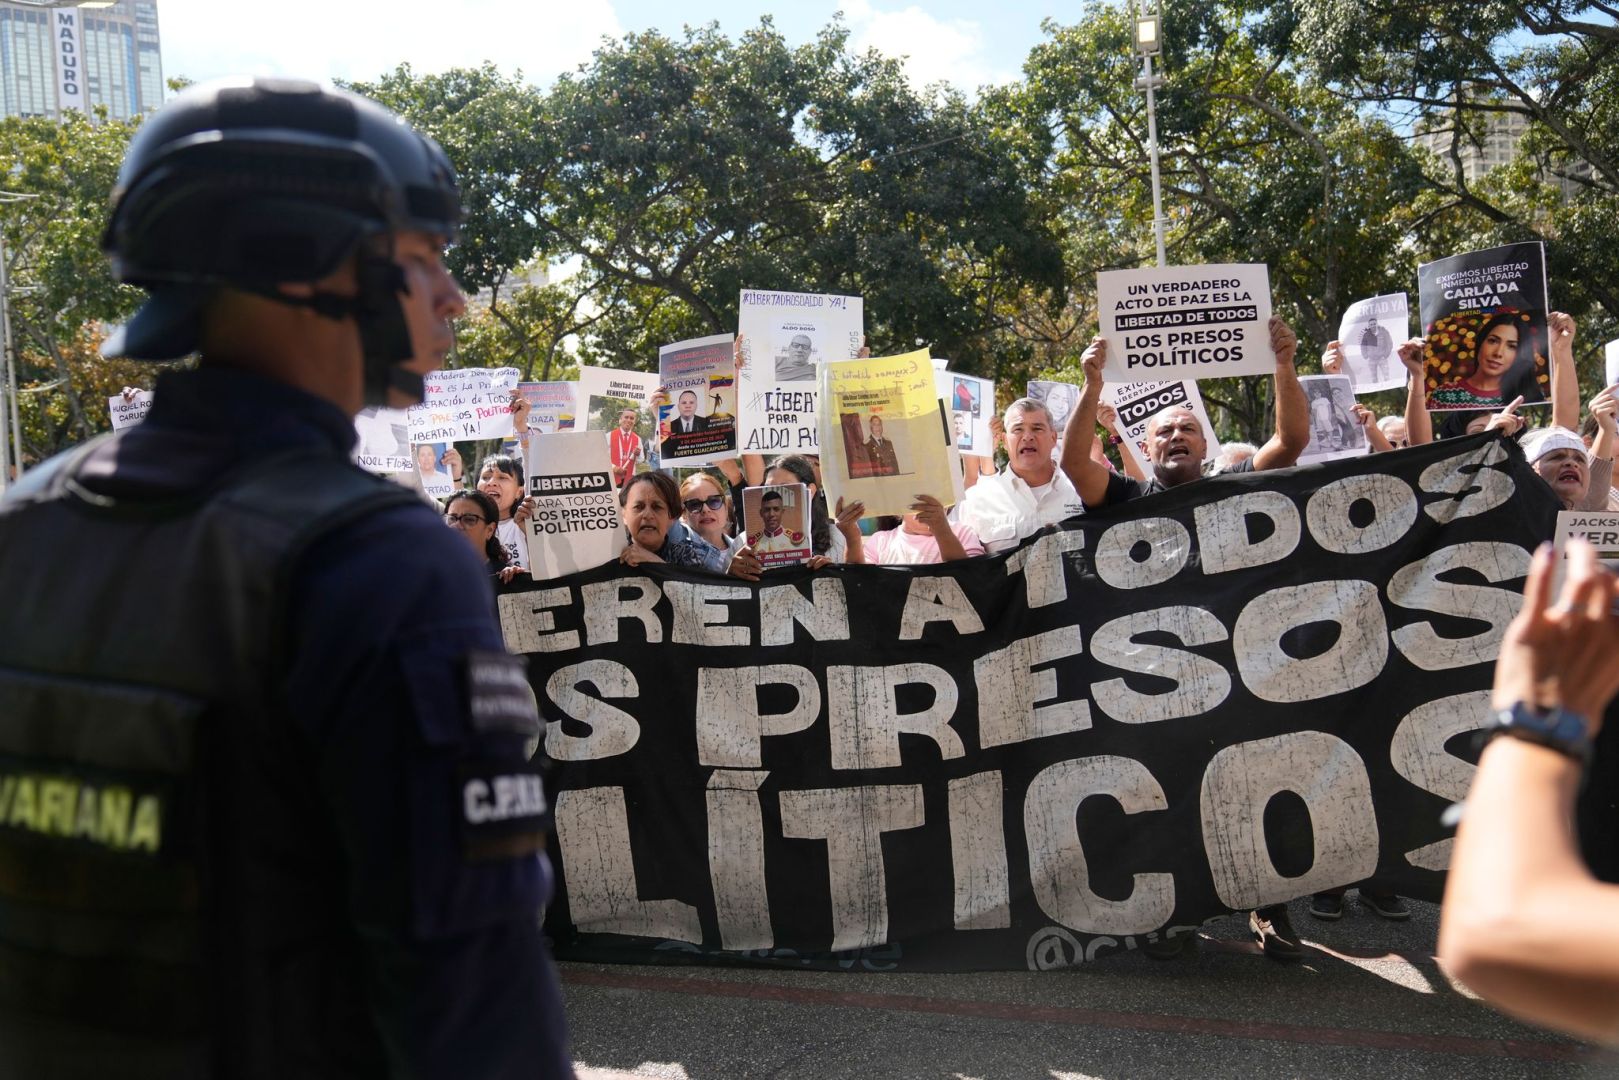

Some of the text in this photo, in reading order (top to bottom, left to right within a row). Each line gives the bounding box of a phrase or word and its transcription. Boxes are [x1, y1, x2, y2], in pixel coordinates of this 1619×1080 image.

[58, 13, 78, 95] MADURO
[1436, 262, 1528, 284] EXIGIMOS LIBERTAD
[1441, 270, 1522, 289] INMEDIATA PARA
[1128, 279, 1240, 295] UN VERDADERO
[1444, 282, 1519, 300] CARLA DA
[829, 296, 847, 310] YA!
[1115, 292, 1251, 311] ACTO DE PAZ ES LA
[1458, 295, 1502, 310] SILVA
[1117, 308, 1256, 328] LIBERTAD DE TODOS
[1126, 328, 1244, 349] LOS PRESOS
[1127, 346, 1244, 369] POLÍTICOS
[610, 380, 631, 390] Libertad
[685, 378, 706, 387] DAZA
[1120, 387, 1184, 422] TODOS
[768, 414, 797, 424] PARA
[463, 421, 481, 437] YA!
[1127, 424, 1145, 438] LOS
[744, 427, 789, 450] ALDO
[530, 475, 605, 491] LIBERTAD
[566, 494, 613, 506] TODOS
[532, 506, 616, 522] LOS PRESOS
[1569, 518, 1619, 526] JACKS
[533, 515, 619, 535] POLÍTICOS
[899, 576, 984, 640] A
[1006, 437, 1516, 609] TODOS
[525, 659, 641, 760] S
[696, 541, 1534, 771] PRESOS
